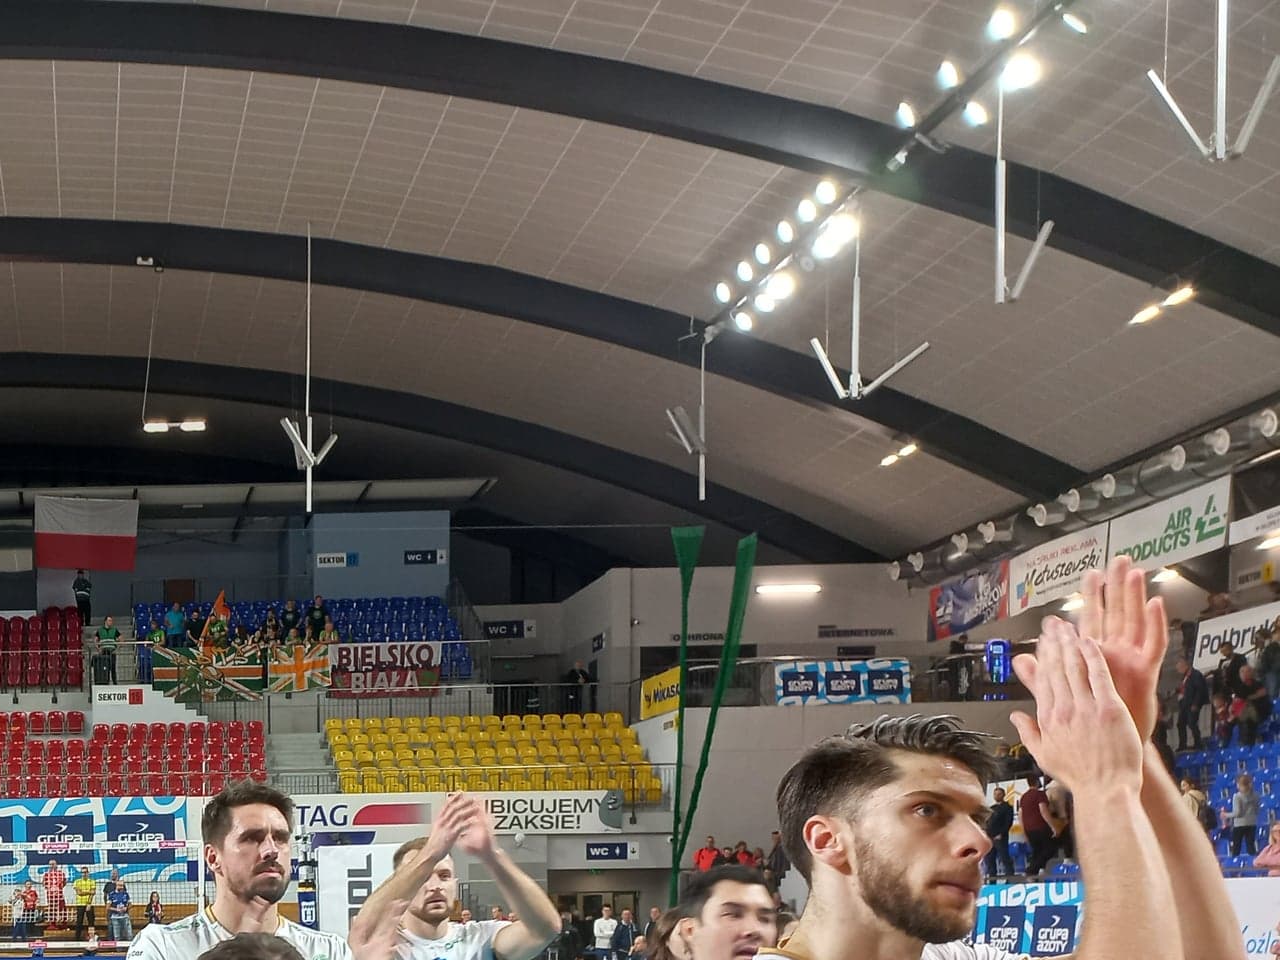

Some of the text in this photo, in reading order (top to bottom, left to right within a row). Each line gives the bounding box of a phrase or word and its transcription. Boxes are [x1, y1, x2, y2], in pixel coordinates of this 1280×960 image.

[1164, 507, 1192, 533] AIR
[319, 556, 345, 564] SEKTOR
[406, 553, 422, 561] WC
[488, 625, 507, 634] WC
[673, 633, 724, 641] OHRONA
[337, 643, 434, 668] BIELSKO
[351, 671, 419, 694] BIAŁA
[98, 692, 127, 701] SEKTOR
[484, 799, 604, 814] IBICUJEMY
[494, 814, 581, 830] ZAKSIE!
[590, 847, 609, 856] WC
